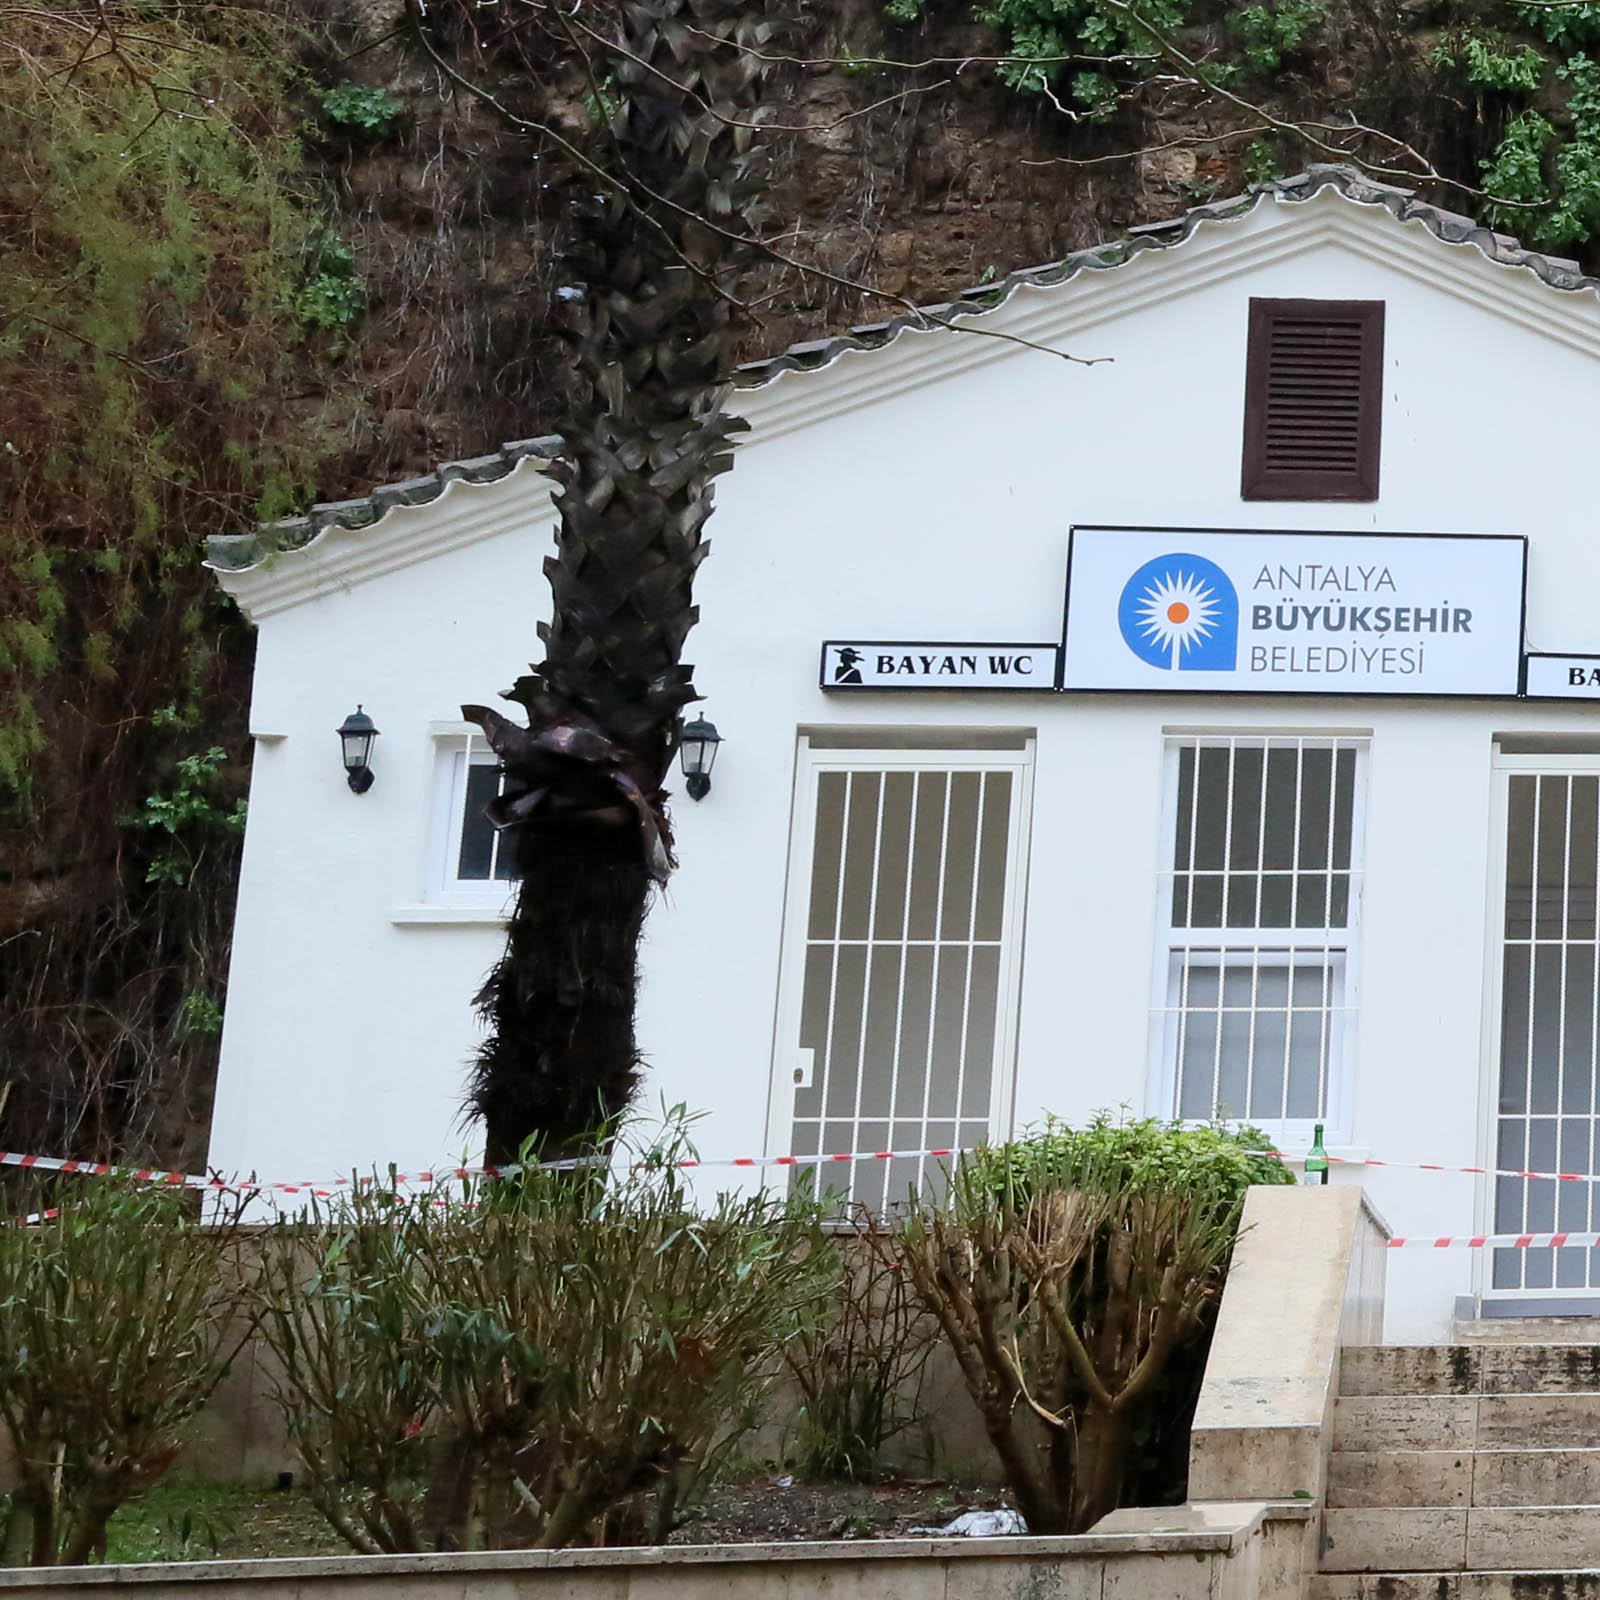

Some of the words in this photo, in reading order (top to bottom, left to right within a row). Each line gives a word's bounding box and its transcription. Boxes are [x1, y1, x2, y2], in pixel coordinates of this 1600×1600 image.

[1252, 564, 1396, 592] ANTALYA
[1251, 597, 1472, 639] BÜYÜKŞEHİR
[876, 655, 977, 675] BAYAN
[988, 656, 1033, 675] WC
[1250, 639, 1424, 674] BELEDİYESİ
